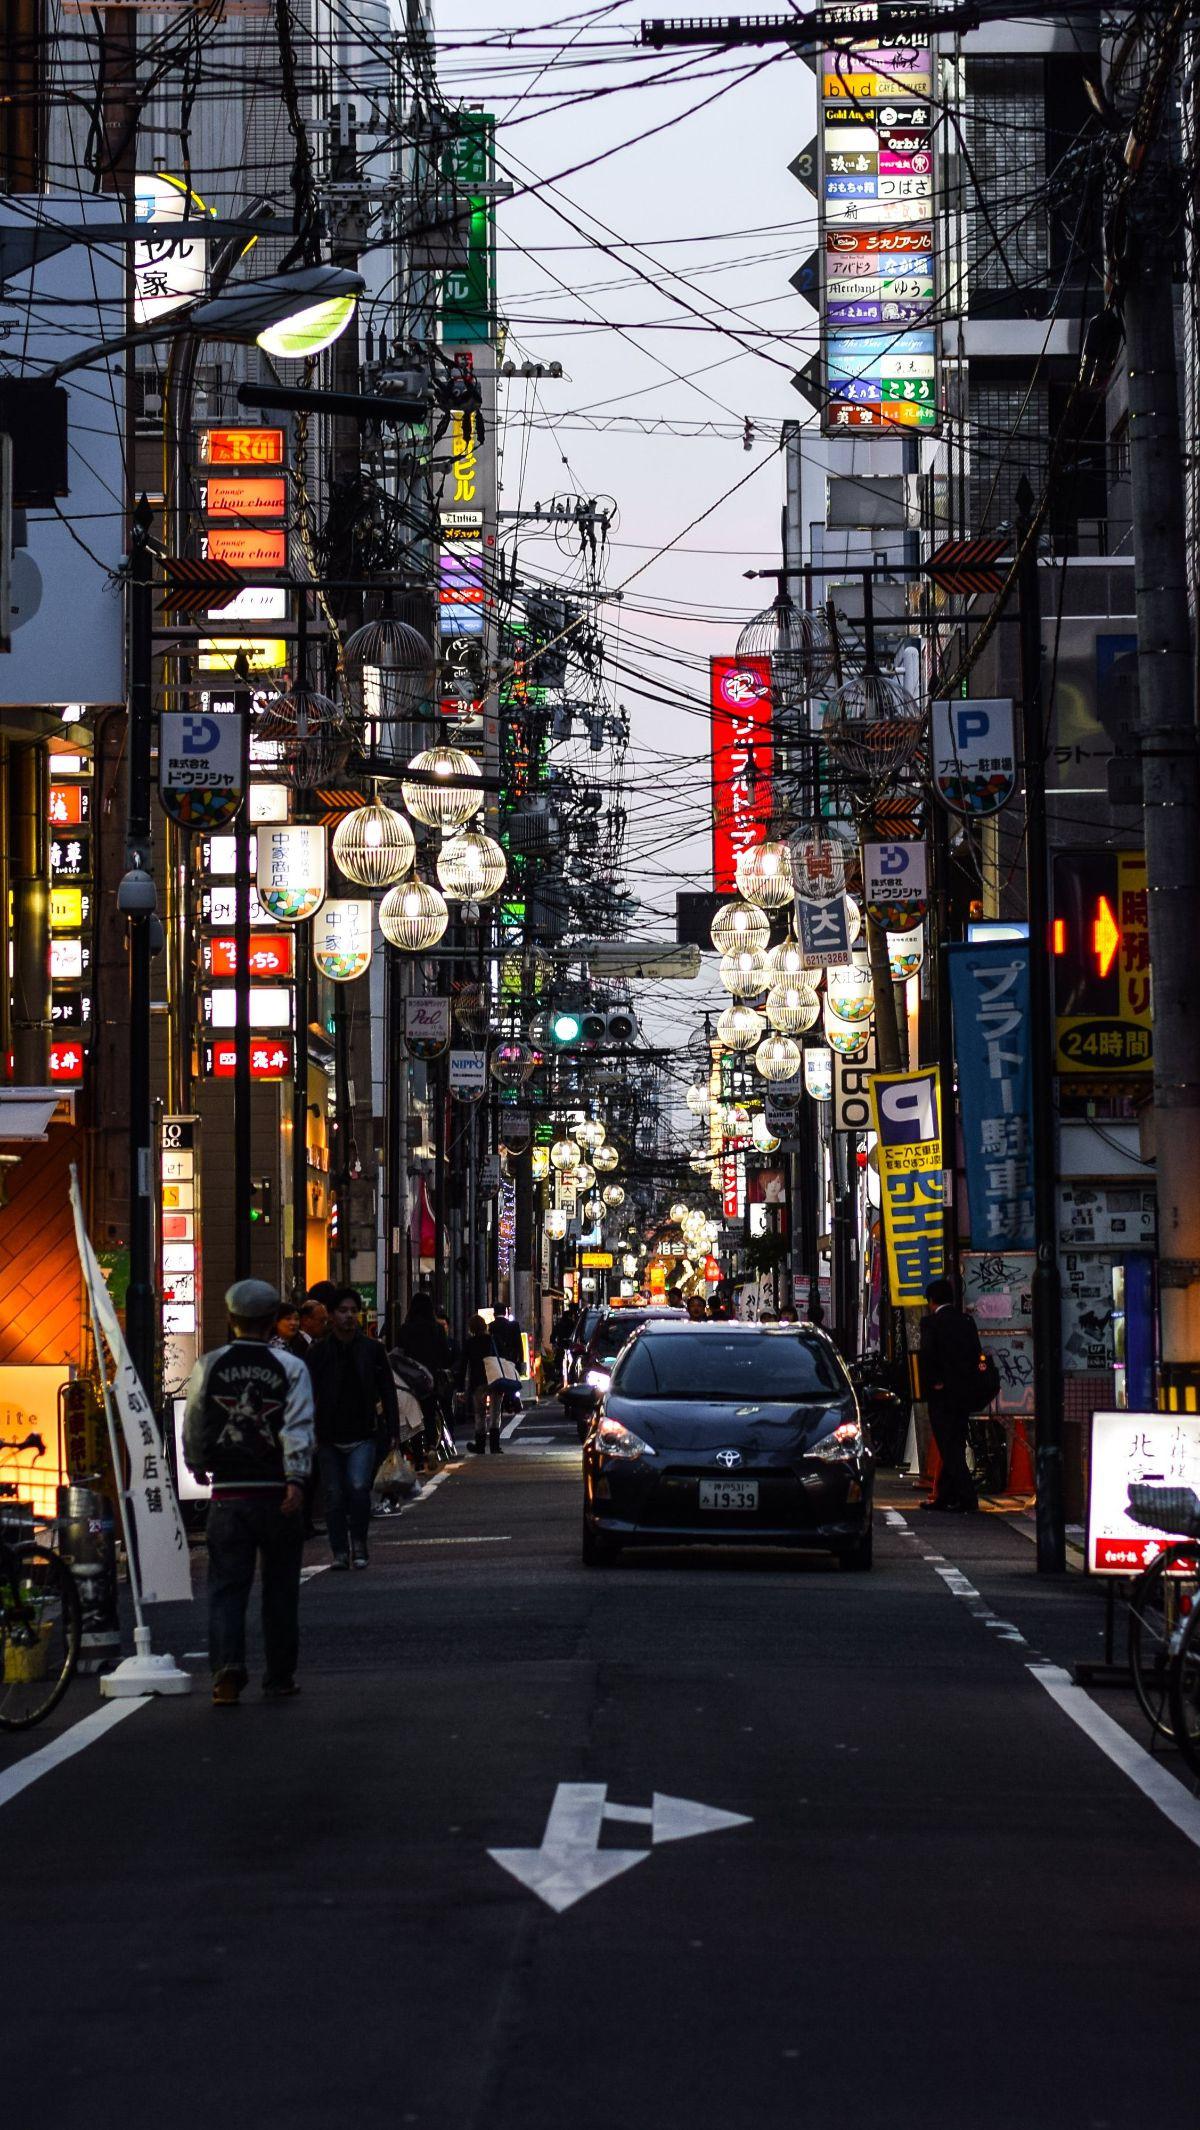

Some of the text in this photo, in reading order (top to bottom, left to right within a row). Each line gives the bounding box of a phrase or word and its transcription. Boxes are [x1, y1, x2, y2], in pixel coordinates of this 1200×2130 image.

[826, 109, 847, 120] Gold
[880, 179, 928, 195] つばさ
[142, 270, 169, 297] 家
[894, 280, 921, 298] ゆう
[889, 380, 930, 399] ことう
[214, 487, 245, 496] Lounge
[212, 497, 281, 509] chou chou
[215, 539, 246, 548] Lounge
[213, 548, 281, 560] chou chou
[957, 710, 990, 749] P
[168, 758, 210, 770] 株式会社
[938, 757, 1012, 774] プラトー駐車場
[167, 771, 235, 785] ドウシシャ
[271, 832, 290, 887] 中家商店
[871, 878, 903, 887] 株式会社
[871, 887, 922, 900] ドウシシャ
[325, 911, 341, 951] 中家
[805, 951, 848, 967] 6211-3268
[1066, 1030, 1149, 1058] 24時間
[451, 1059, 484, 1070] NIPPO
[972, 960, 1034, 1240] プラトー駐車場
[217, 1365, 284, 1390] VANSON
